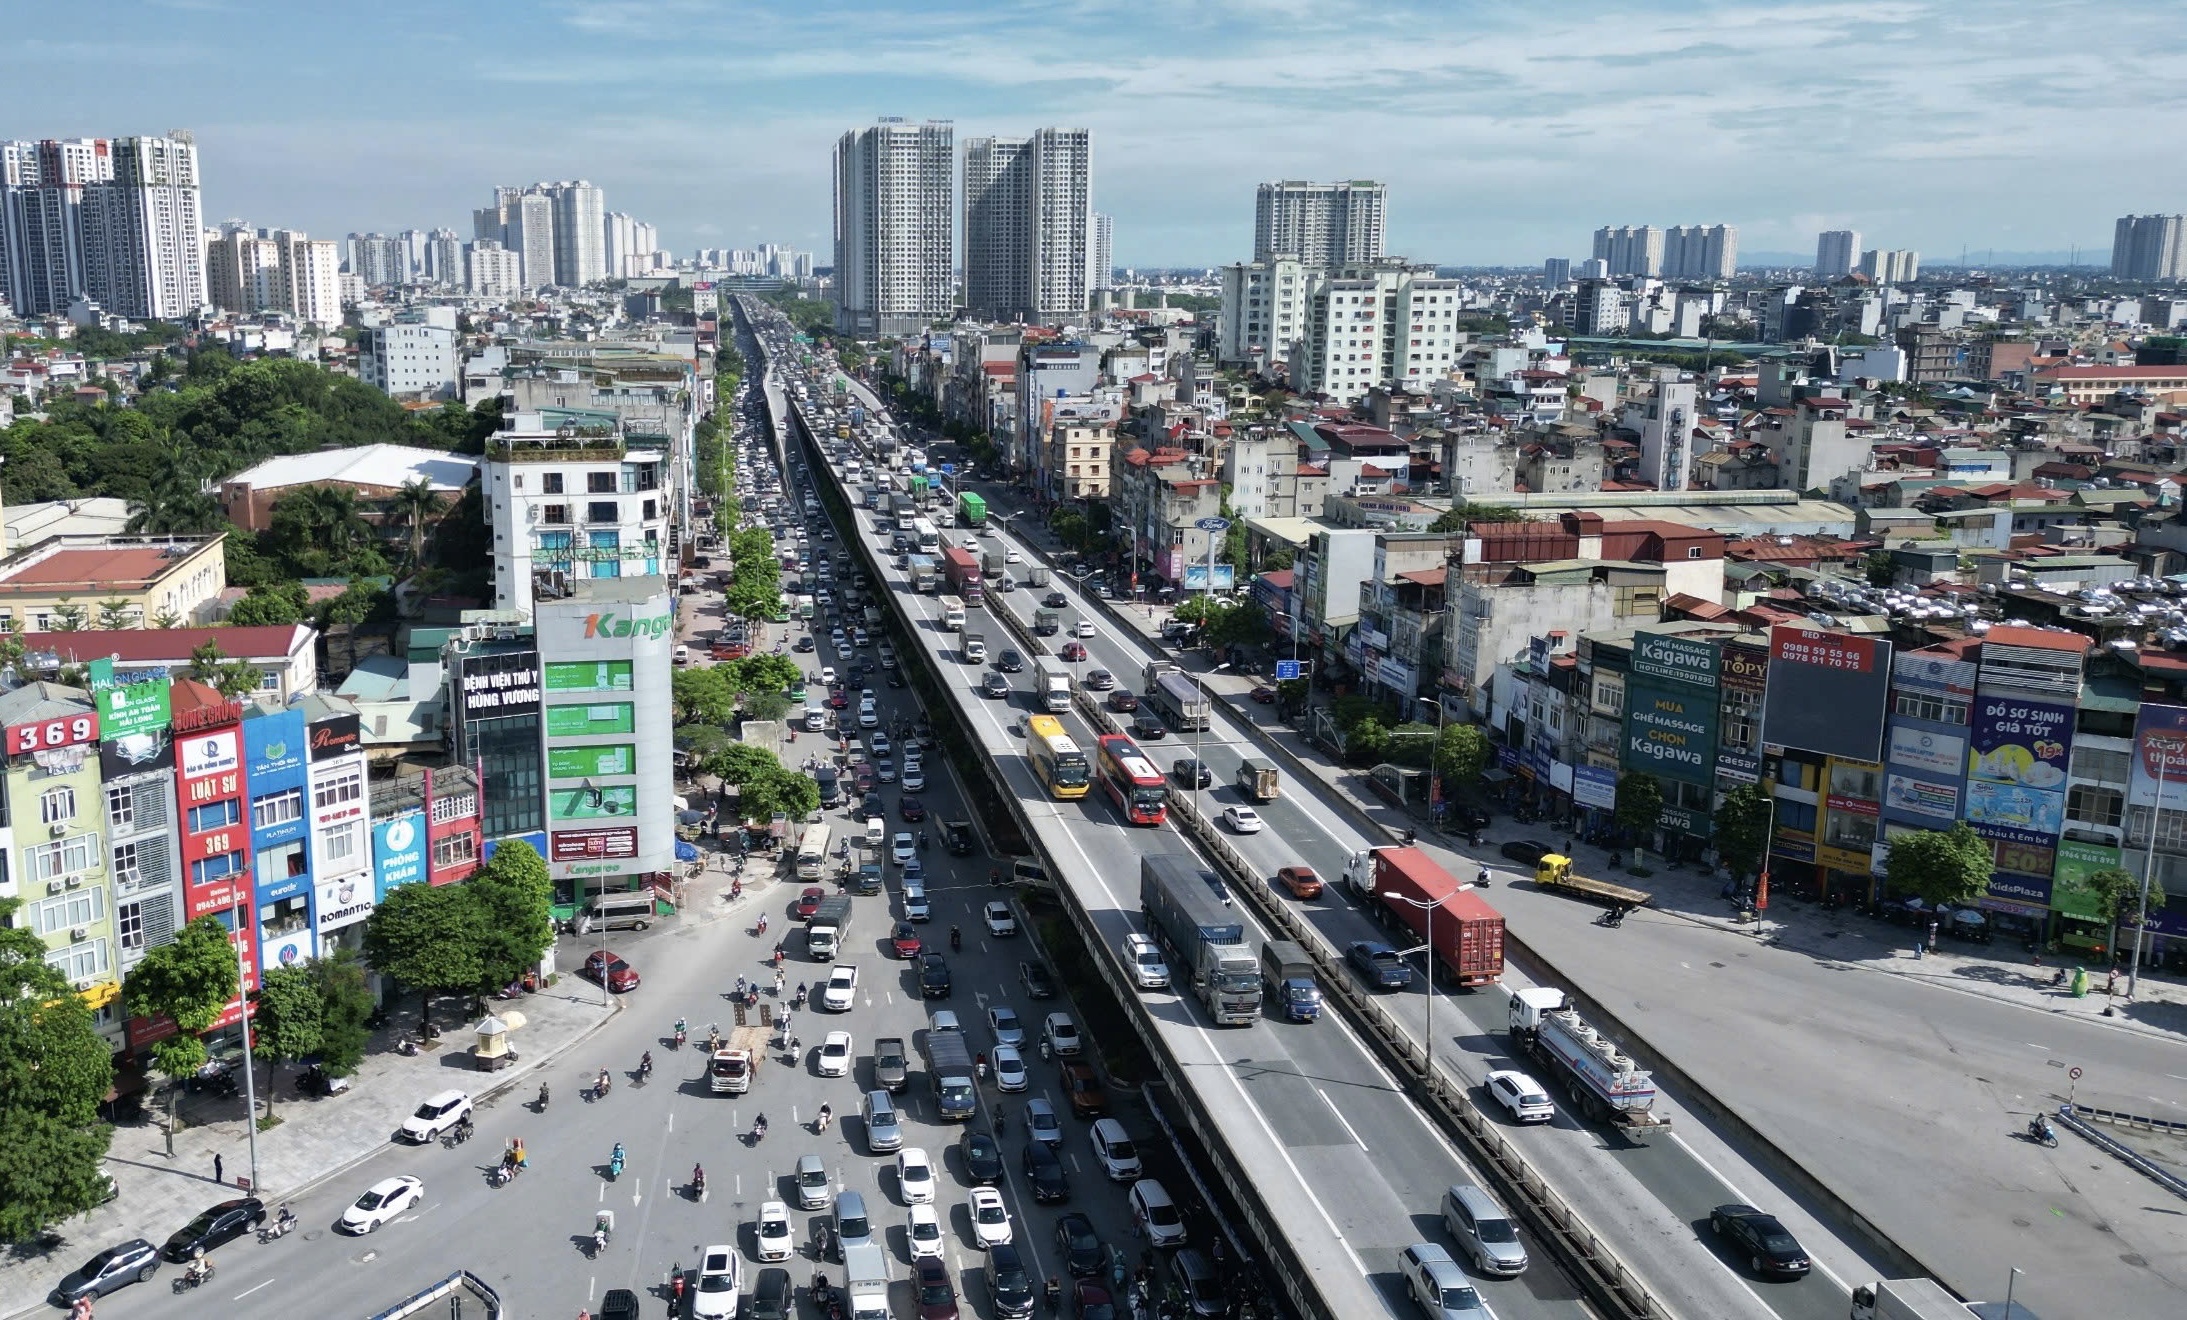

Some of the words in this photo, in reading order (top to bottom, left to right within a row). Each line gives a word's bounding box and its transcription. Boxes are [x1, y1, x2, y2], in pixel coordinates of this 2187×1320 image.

[1203, 520, 1224, 529] Ford
[1802, 631, 1820, 639] RED
[1641, 643, 1710, 669] Kagawa
[1672, 643, 1711, 656] MASSAGE
[1721, 660, 1767, 677] TOPY
[464, 675, 489, 692] BỆNH
[490, 672, 512, 691] VIỆN
[512, 668, 530, 686] THÚ
[530, 670, 538, 684] Y
[468, 692, 499, 708] HÙNG
[501, 689, 540, 706] VƯƠNG
[1655, 700, 1683, 714] MUA
[1986, 701, 2006, 717] ĐỒ
[2030, 710, 2064, 724] SINH
[1655, 716, 1705, 734] MASSAGE
[2024, 722, 2052, 737] TỐT
[1631, 736, 1702, 764] Kagawa
[191, 777, 217, 800] LUẬT
[222, 772, 238, 794] SƯ
[1662, 807, 1692, 820] ASSAGE
[205, 833, 230, 854] 369
[2018, 833, 2034, 842] Em
[383, 851, 419, 869] PHÒNG
[385, 865, 417, 882] KHÁM
[1989, 881, 2044, 898] KidsPlaza
[320, 901, 372, 923] ROMANTIC
